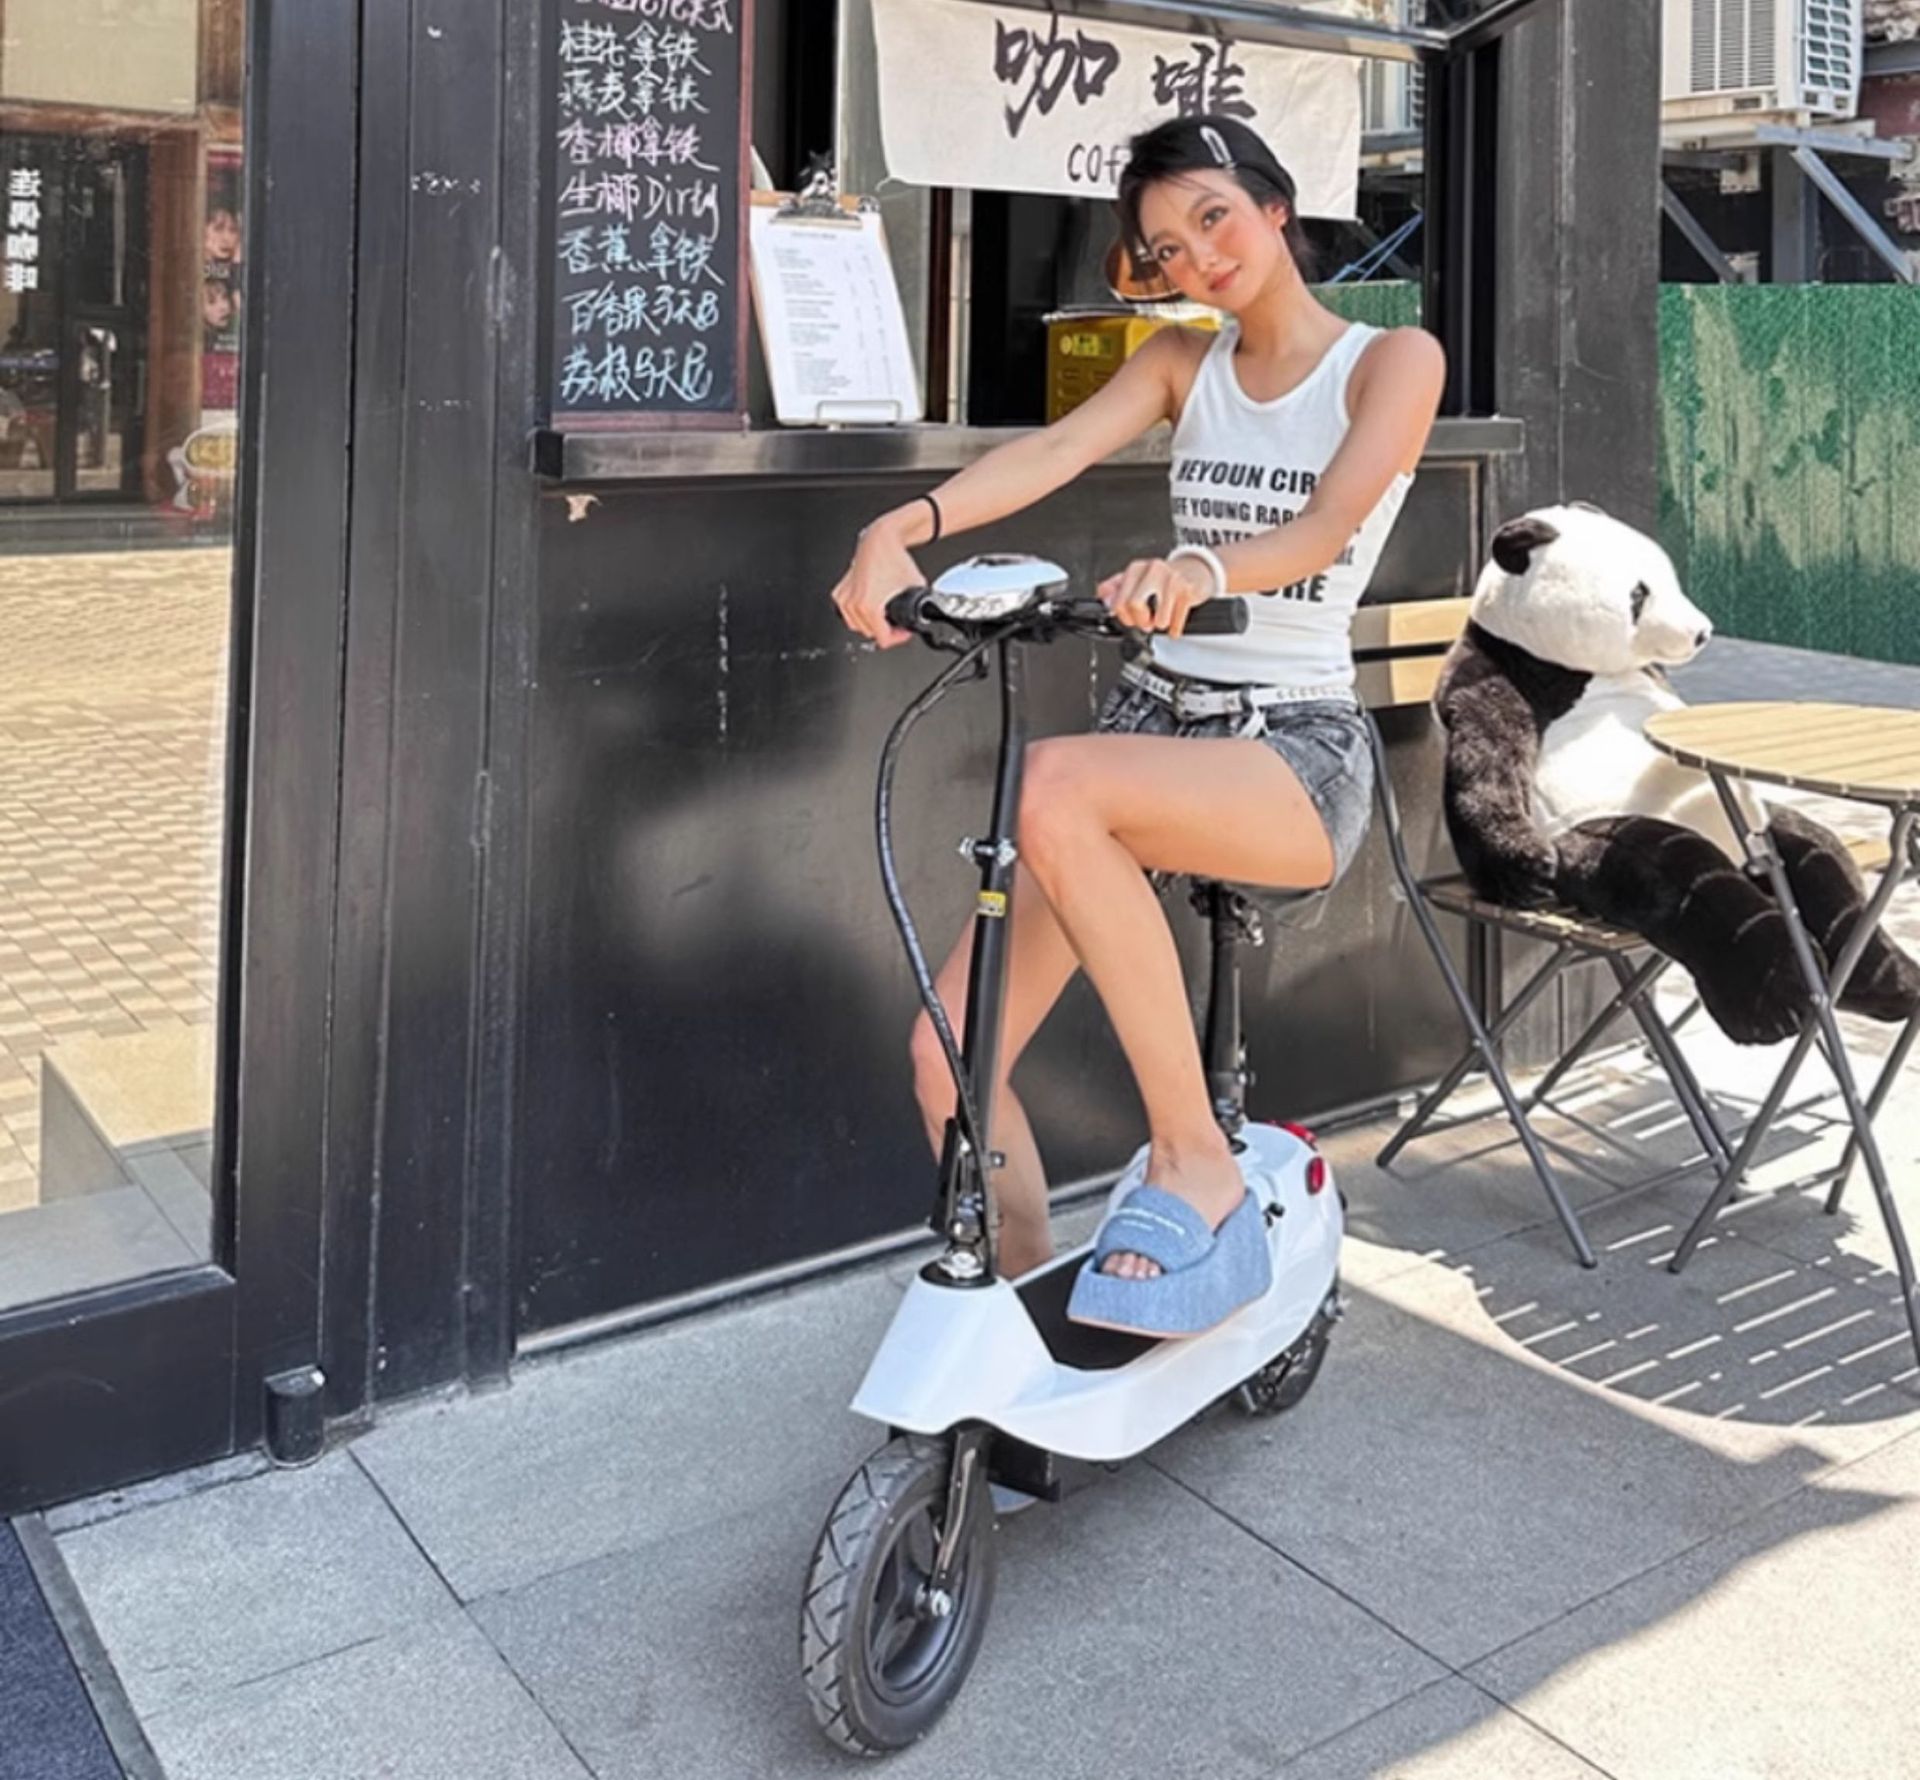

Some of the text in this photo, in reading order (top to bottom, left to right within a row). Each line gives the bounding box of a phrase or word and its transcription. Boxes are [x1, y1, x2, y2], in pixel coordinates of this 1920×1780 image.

[993, 10, 1256, 138] 咖啡
[557, 220, 726, 286] 香蕉拿铁
[1269, 467, 1319, 496] CIR
[1189, 498, 1251, 521] YOUNG
